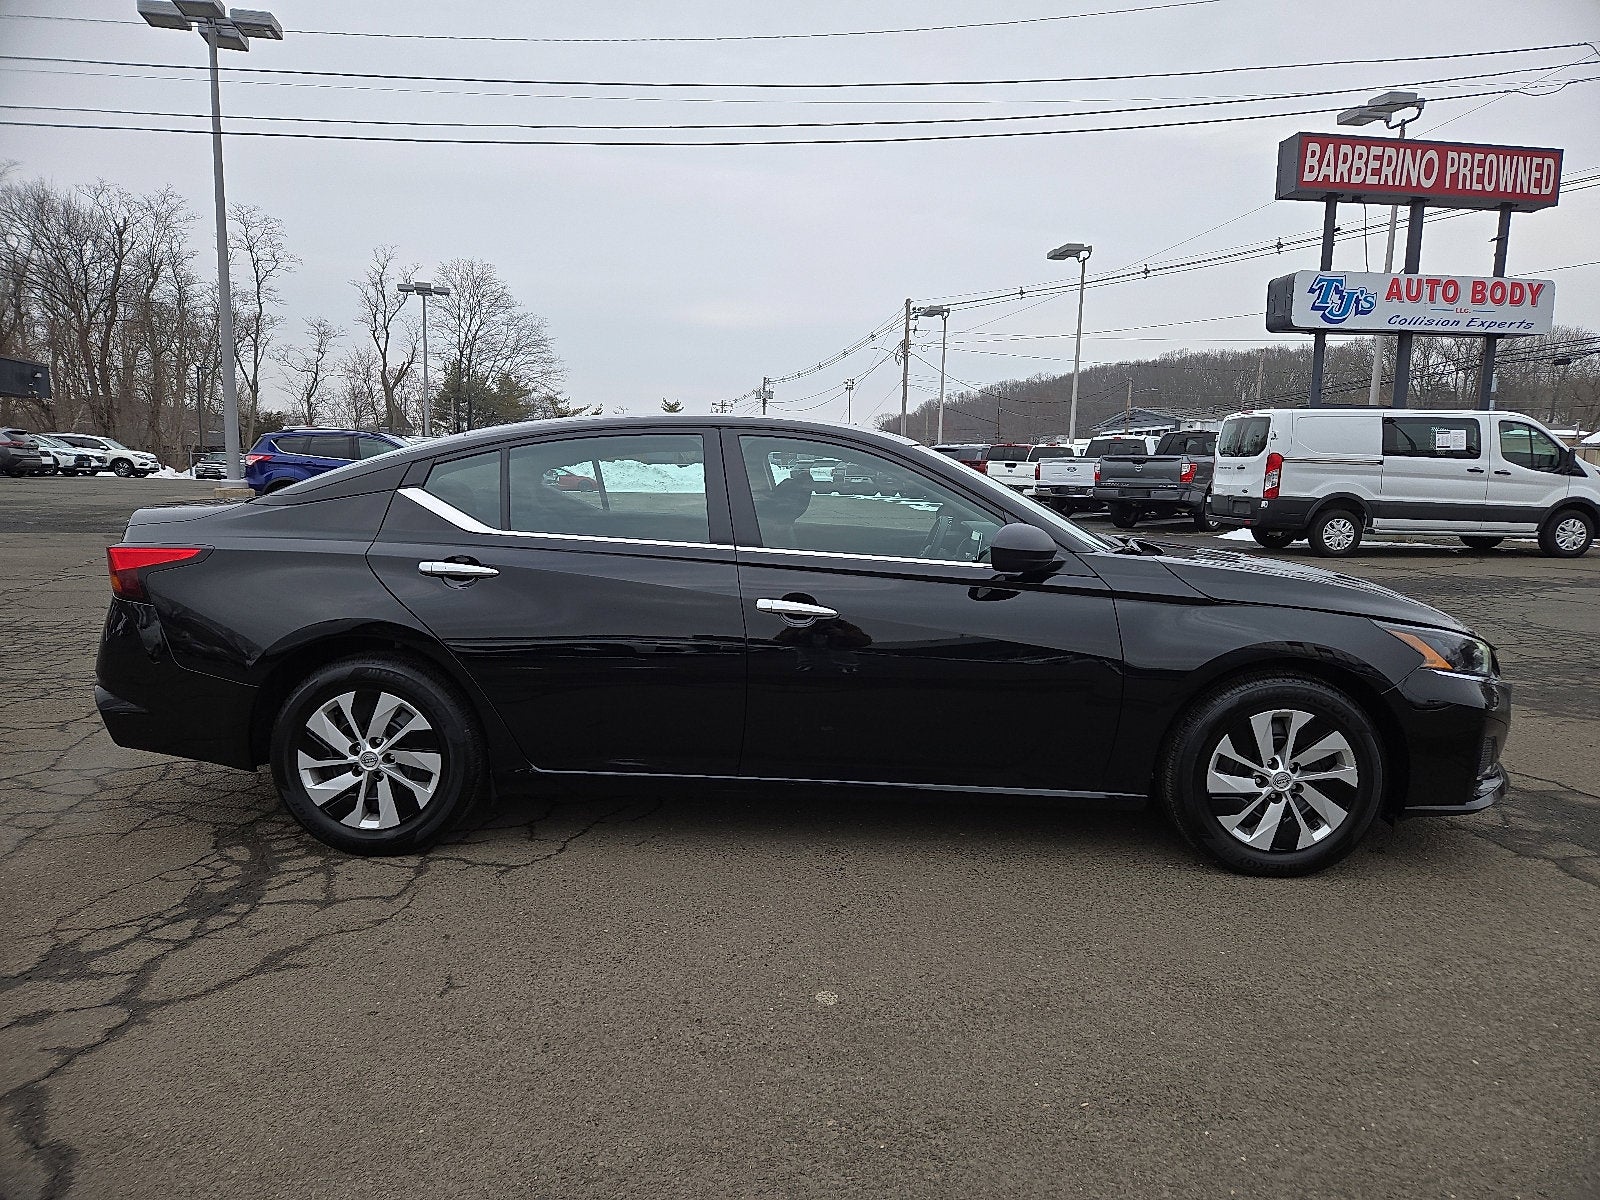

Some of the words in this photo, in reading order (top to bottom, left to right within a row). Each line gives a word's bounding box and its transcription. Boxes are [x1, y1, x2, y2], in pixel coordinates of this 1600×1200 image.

[1303, 142, 1439, 188] BARBERINO
[1445, 151, 1555, 195] PREOWNED
[1385, 277, 1460, 305] AUTO
[1470, 280, 1544, 307] BODY
[1387, 314, 1460, 327] Collision
[1466, 317, 1535, 330] Experts
